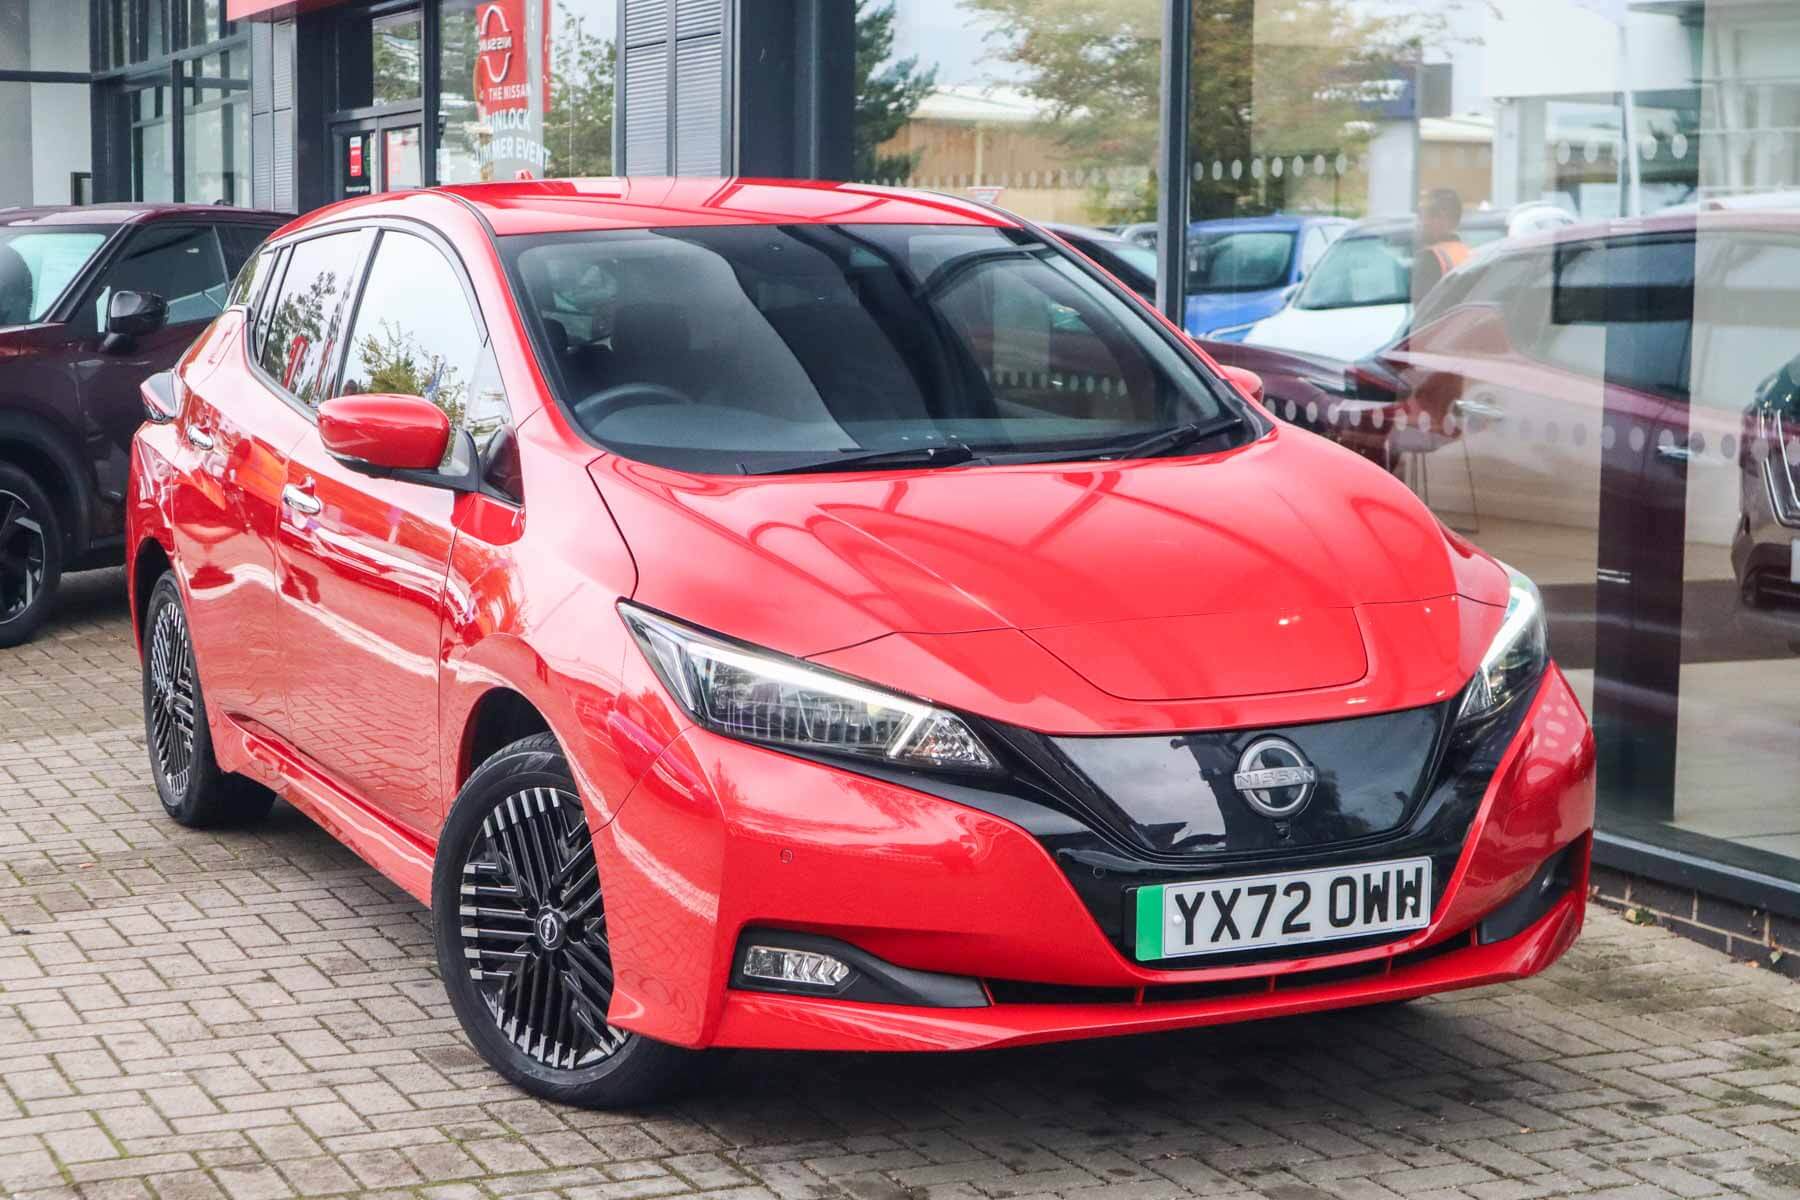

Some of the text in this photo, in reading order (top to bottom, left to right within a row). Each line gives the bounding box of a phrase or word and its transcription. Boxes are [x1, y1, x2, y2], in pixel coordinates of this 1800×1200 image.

[488, 86, 503, 101] THE
[1236, 769, 1314, 788] NISSAN
[1175, 867, 1423, 945] YX72 OWW
